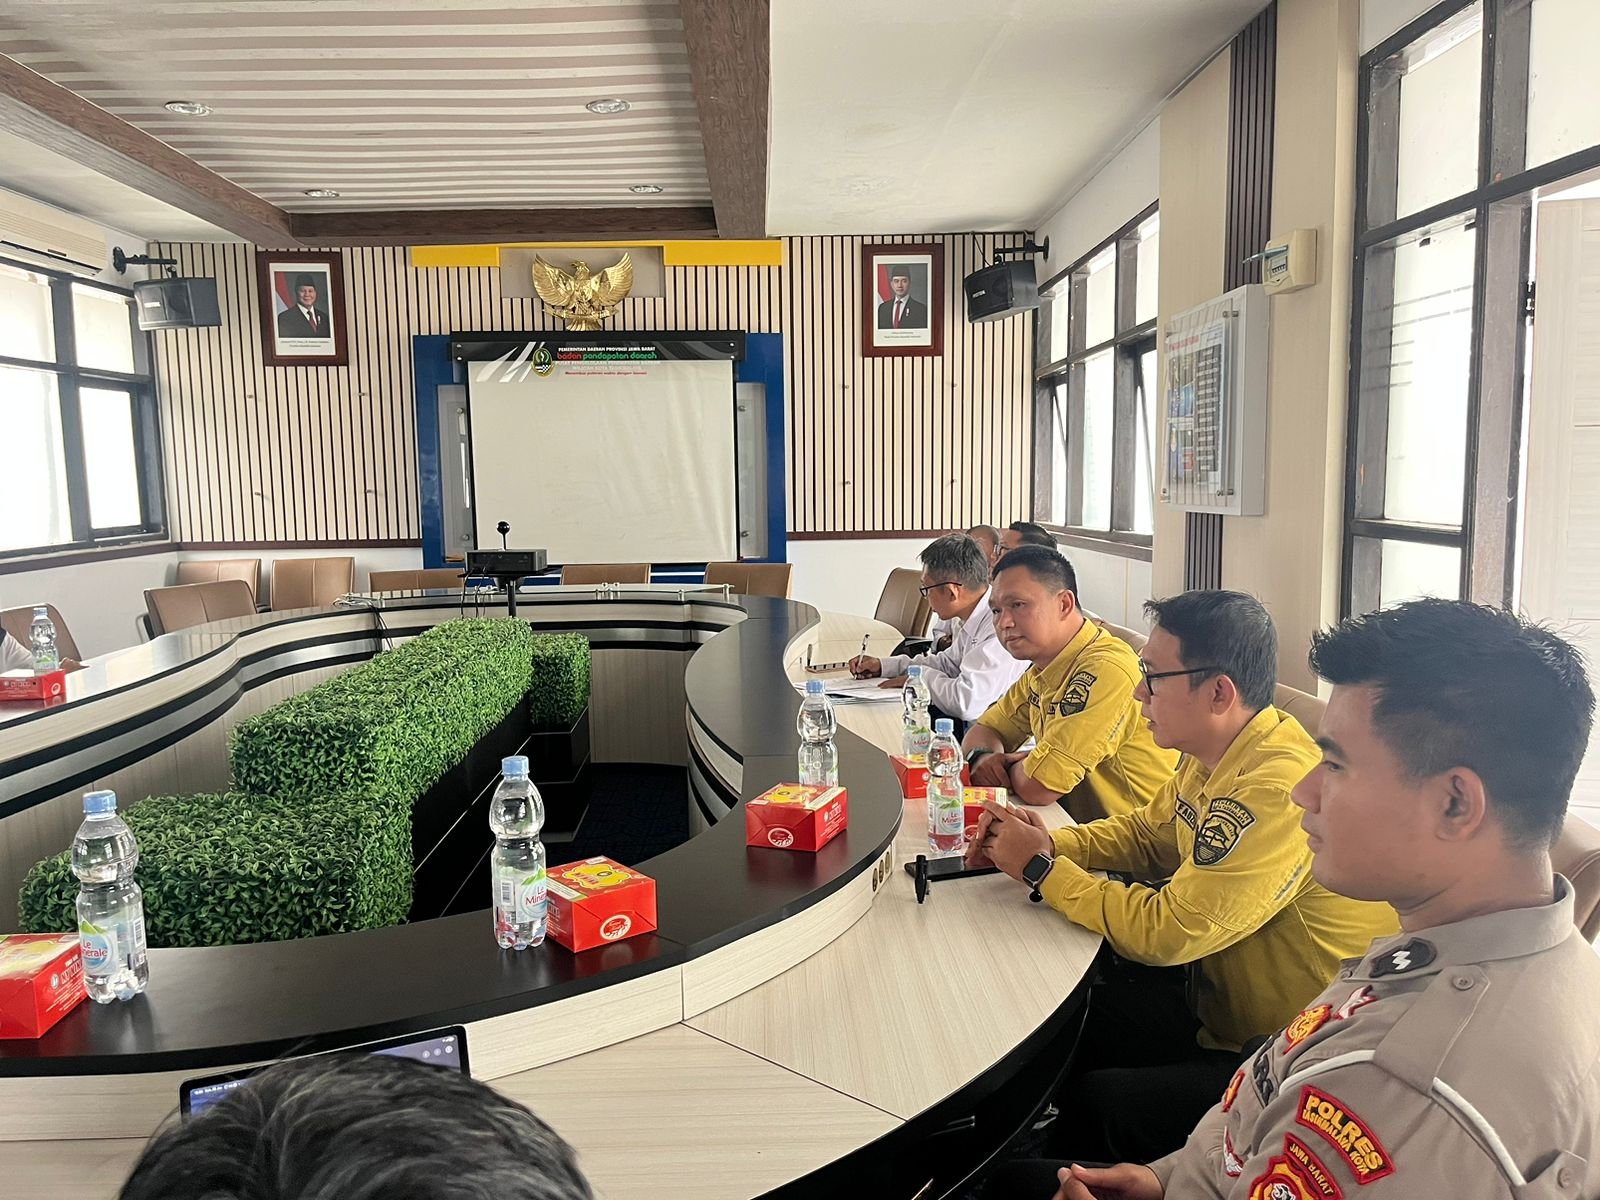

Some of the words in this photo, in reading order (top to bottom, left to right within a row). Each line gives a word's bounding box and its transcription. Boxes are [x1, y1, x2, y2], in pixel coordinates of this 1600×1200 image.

[557, 352, 582, 360] badan
[83, 939, 91, 949] Le
[1305, 1094, 1383, 1169] POLRES
[1289, 1143, 1310, 1165] JAWA
[1308, 1162, 1334, 1196] BARAT
